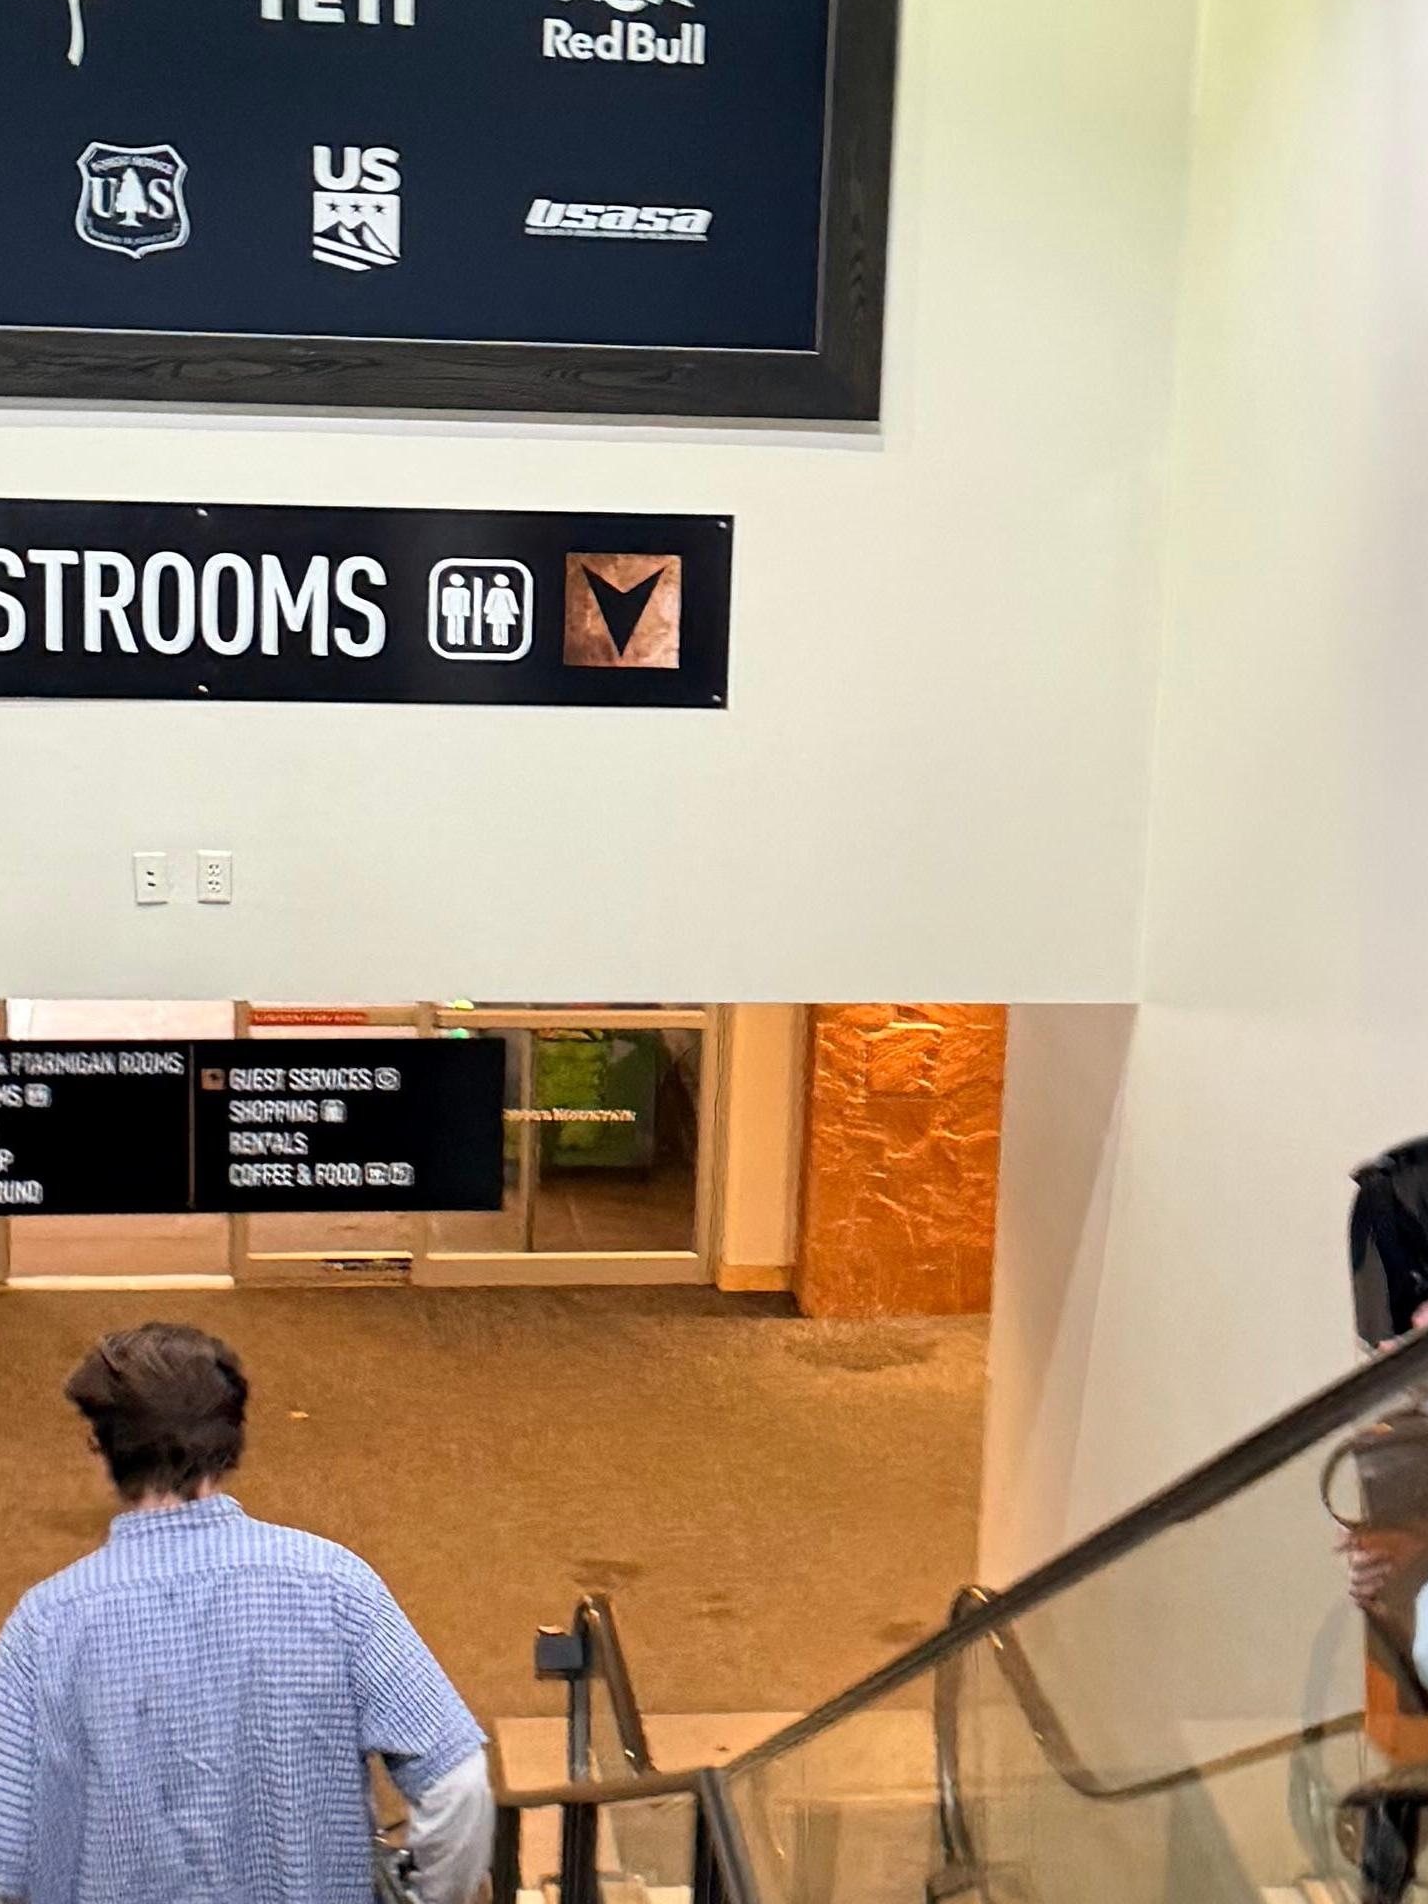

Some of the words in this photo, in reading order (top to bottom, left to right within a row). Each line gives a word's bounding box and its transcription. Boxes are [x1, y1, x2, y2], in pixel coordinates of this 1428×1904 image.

[313, 145, 401, 192] US
[119, 1051, 185, 1076] ROOMS
[229, 1067, 286, 1092] GUEST
[288, 1067, 373, 1092] SERVICES
[228, 1099, 319, 1124] SHOPPING
[228, 1131, 309, 1156] RENTALS
[228, 1162, 295, 1187] COFFEE
[296, 1163, 314, 1187] &
[315, 1163, 364, 1188] FOOD
